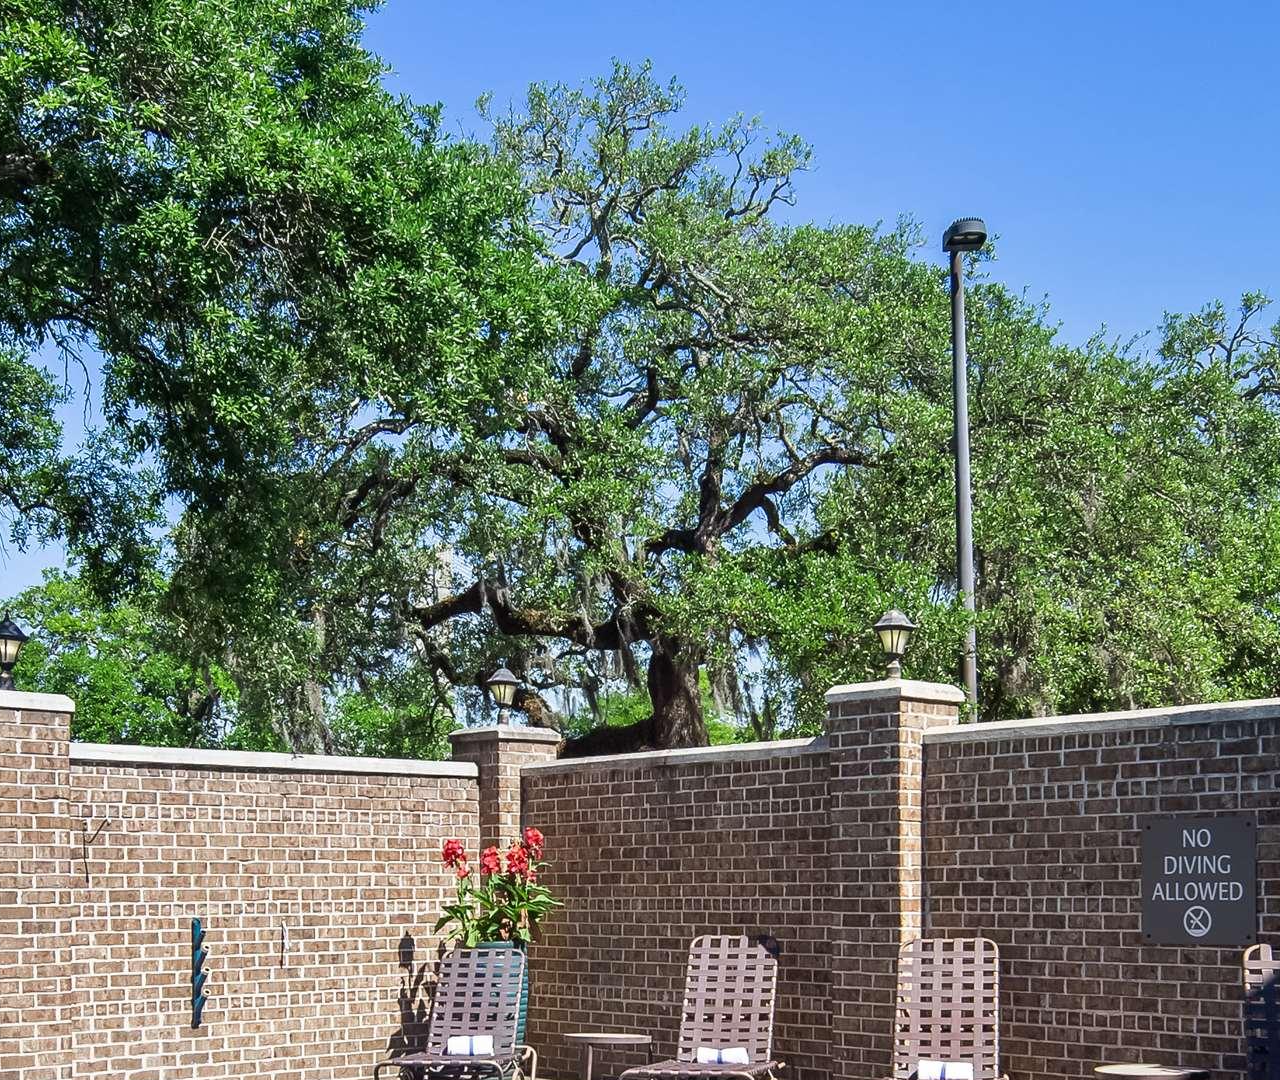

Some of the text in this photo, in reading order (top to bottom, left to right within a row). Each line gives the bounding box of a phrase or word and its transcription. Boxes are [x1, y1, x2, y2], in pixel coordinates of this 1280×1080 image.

[1182, 828, 1212, 849] NO
[1164, 854, 1232, 875] DIVING
[1151, 881, 1244, 901] ALLOWED
